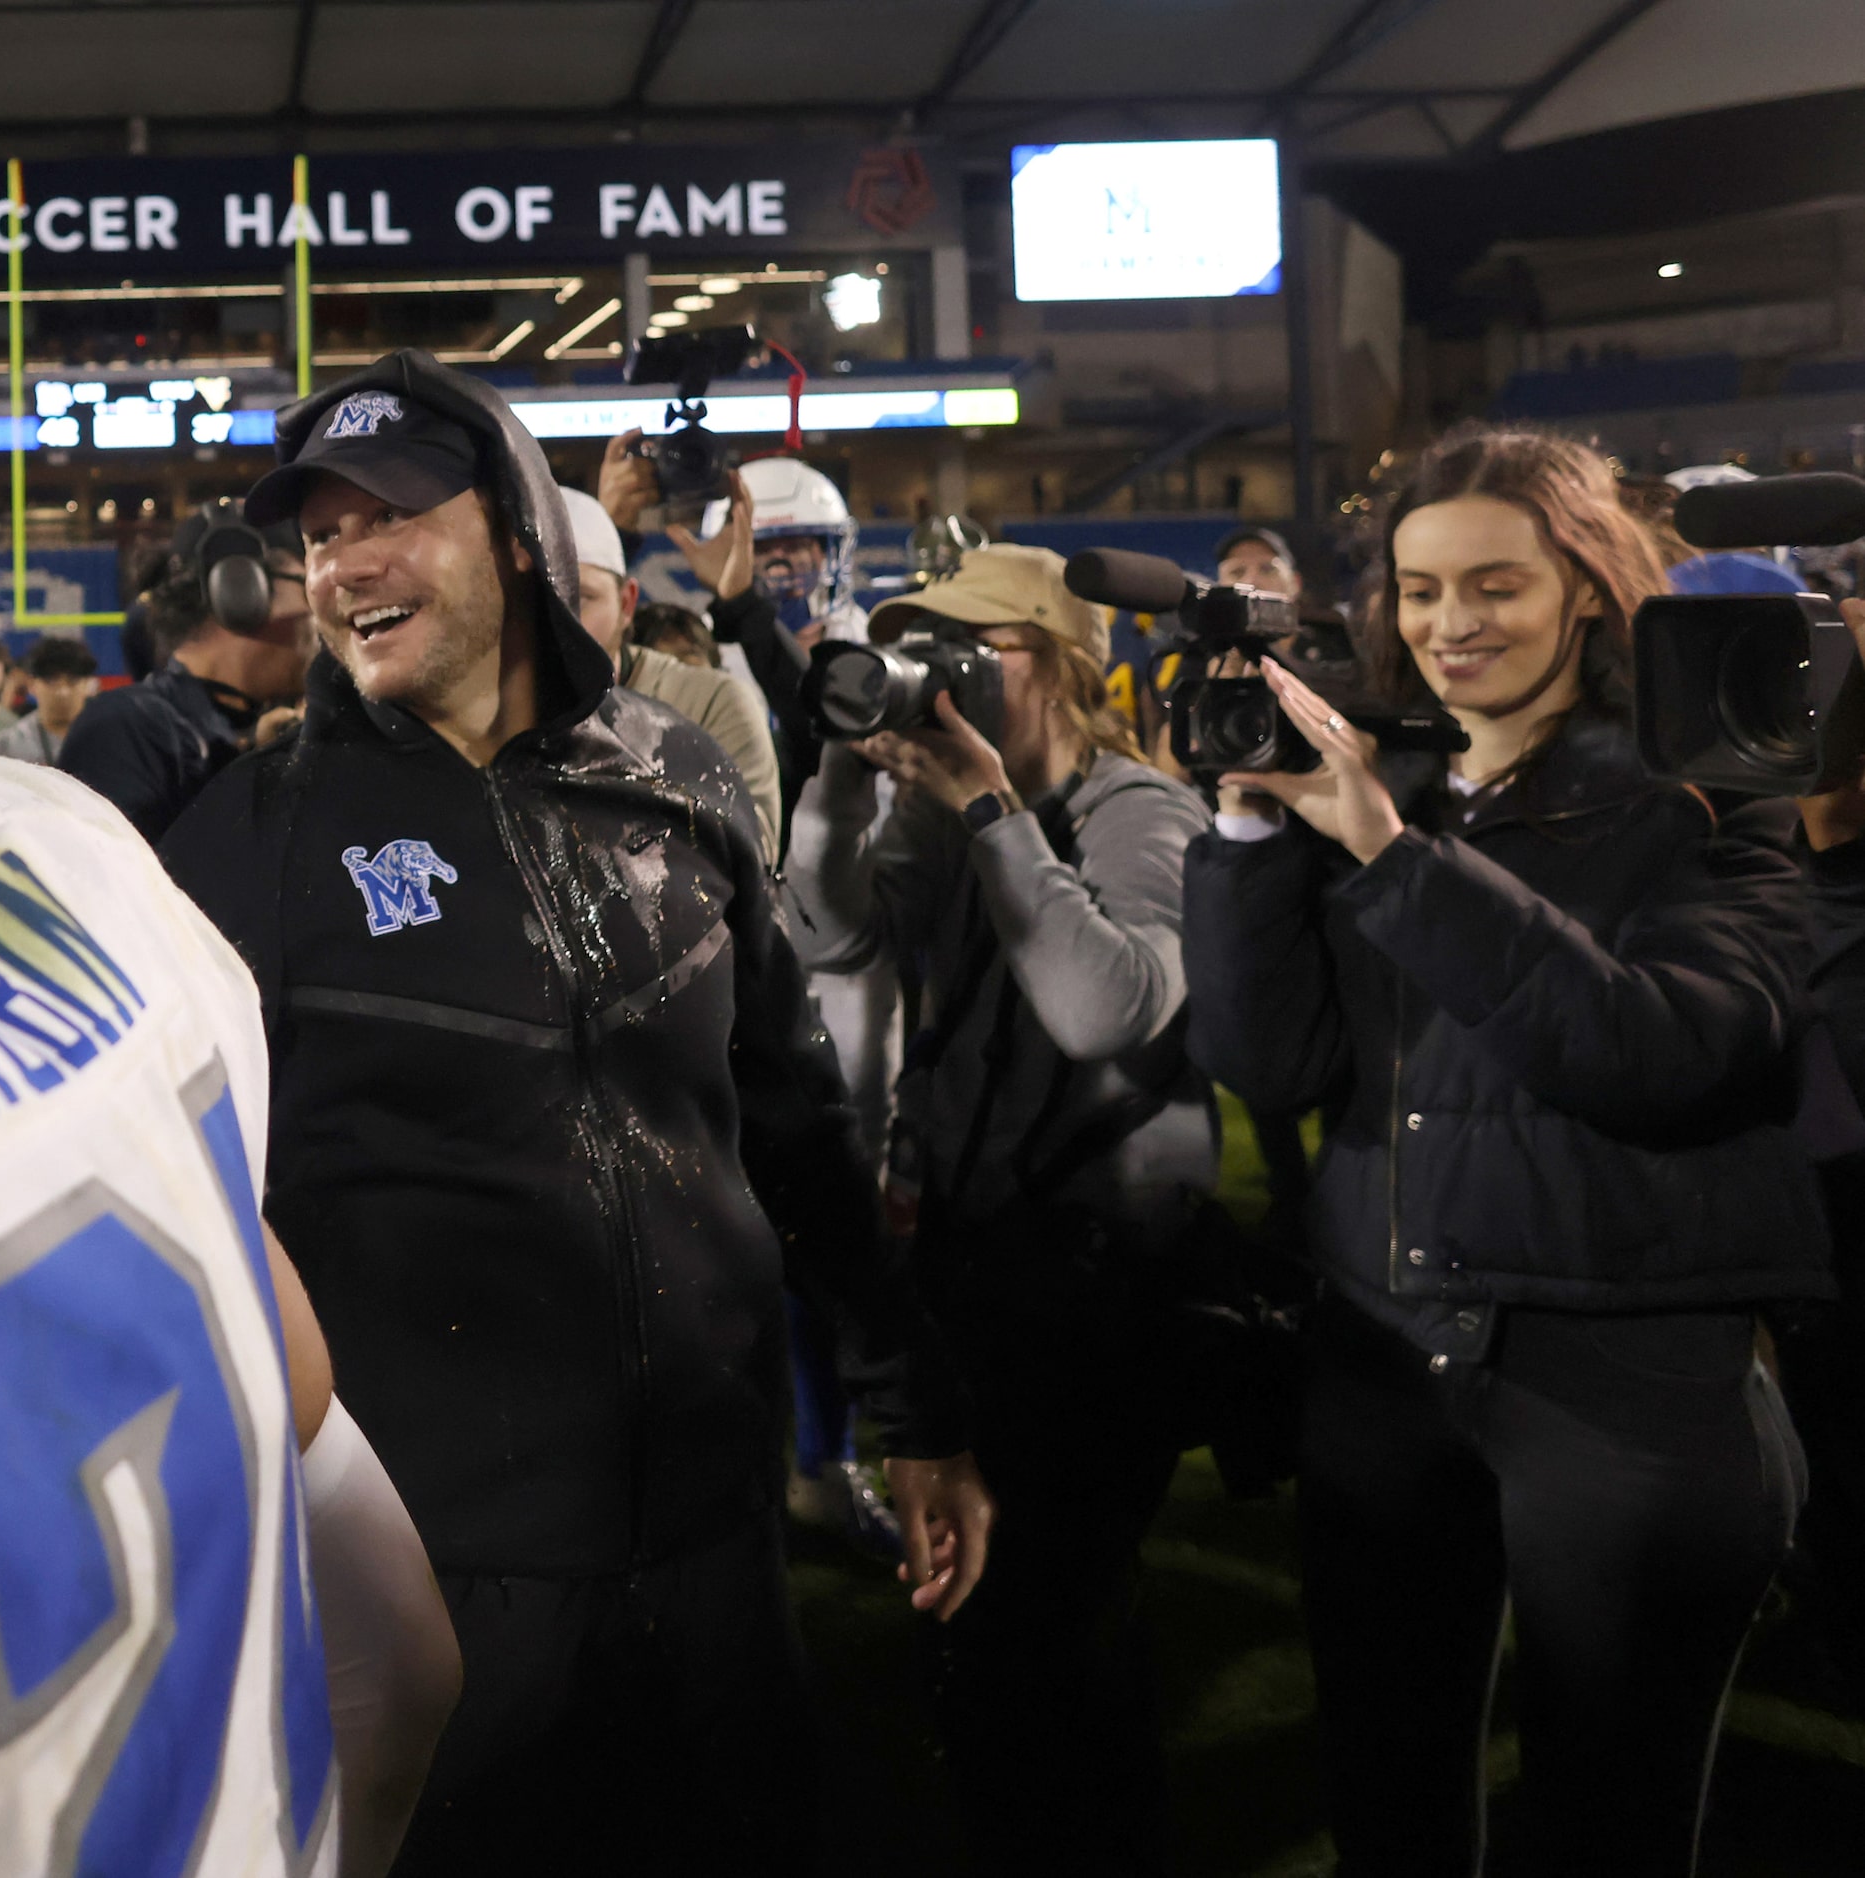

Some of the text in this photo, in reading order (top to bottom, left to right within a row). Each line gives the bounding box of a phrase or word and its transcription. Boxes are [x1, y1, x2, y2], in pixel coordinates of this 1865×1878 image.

[224, 190, 410, 248] HALL
[454, 185, 553, 242] OF
[598, 179, 788, 238] FAME
